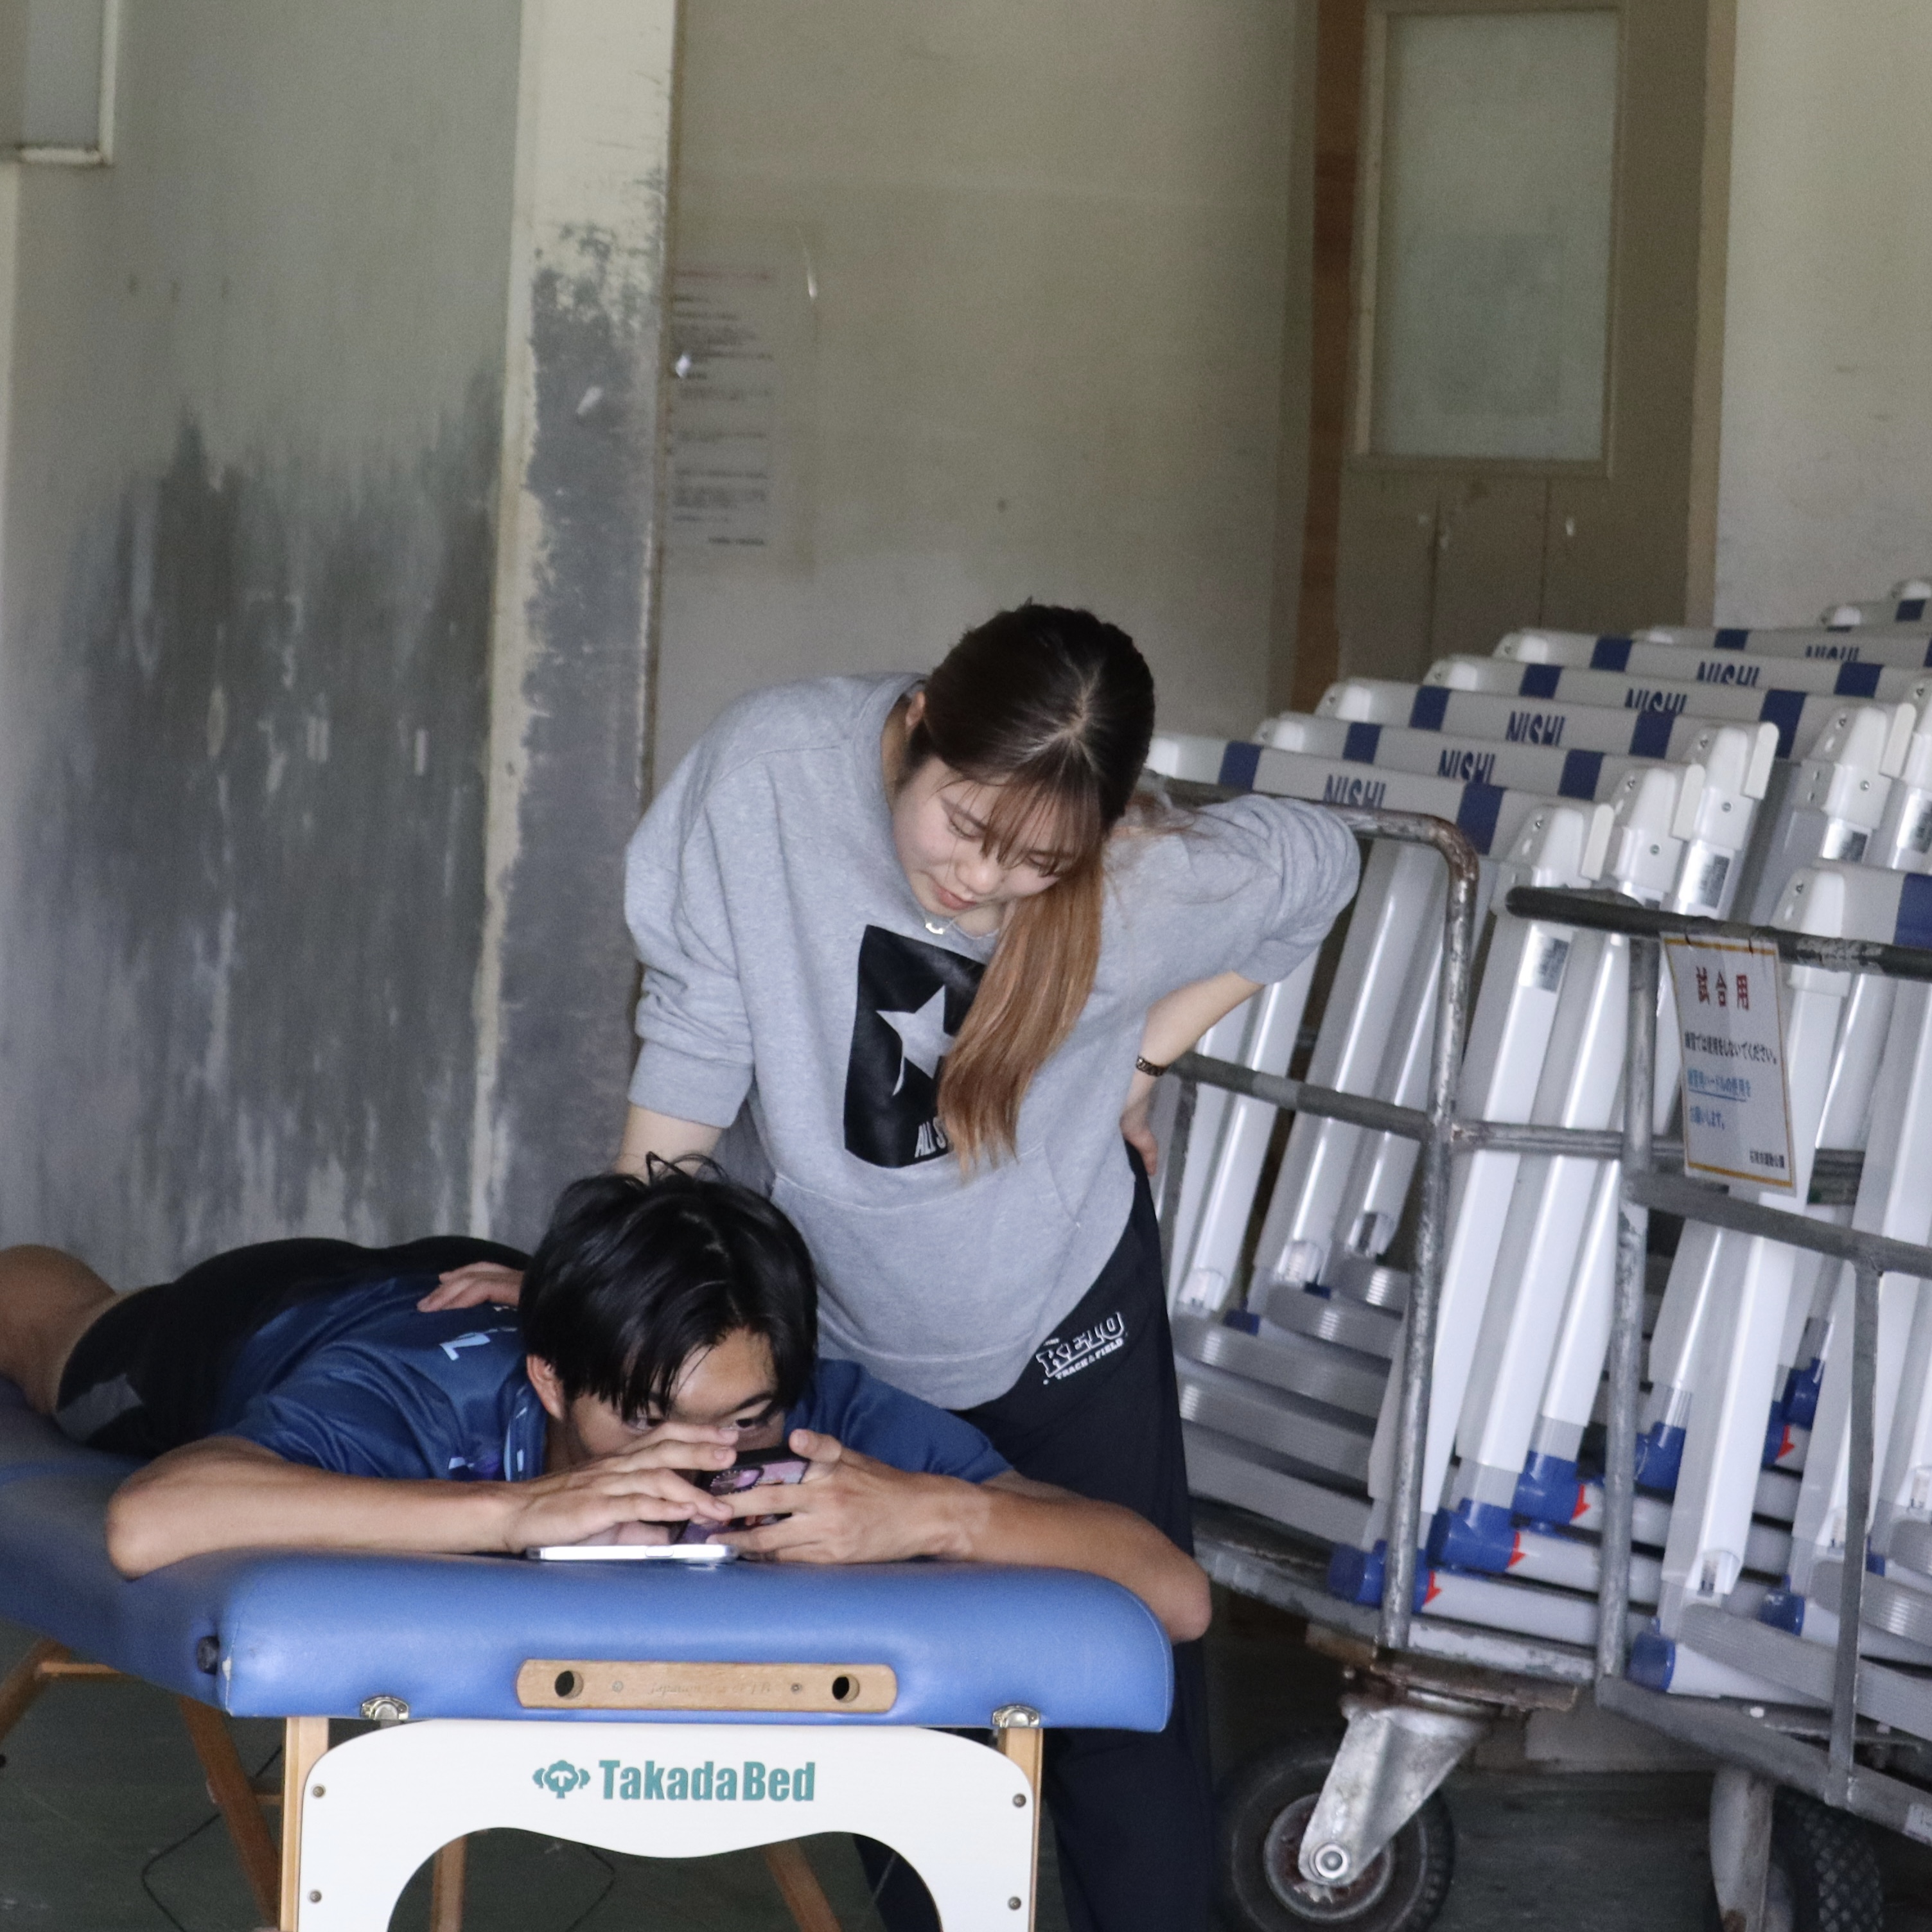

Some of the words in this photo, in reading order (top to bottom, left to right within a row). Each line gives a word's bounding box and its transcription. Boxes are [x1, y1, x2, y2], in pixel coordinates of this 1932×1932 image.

[1506, 710, 1566, 746] NISHI
[1437, 749, 1495, 784] NISHI
[1323, 774, 1386, 809] NISHI
[1696, 965, 1749, 1011] 試合用
[914, 1121, 936, 1158] ALL
